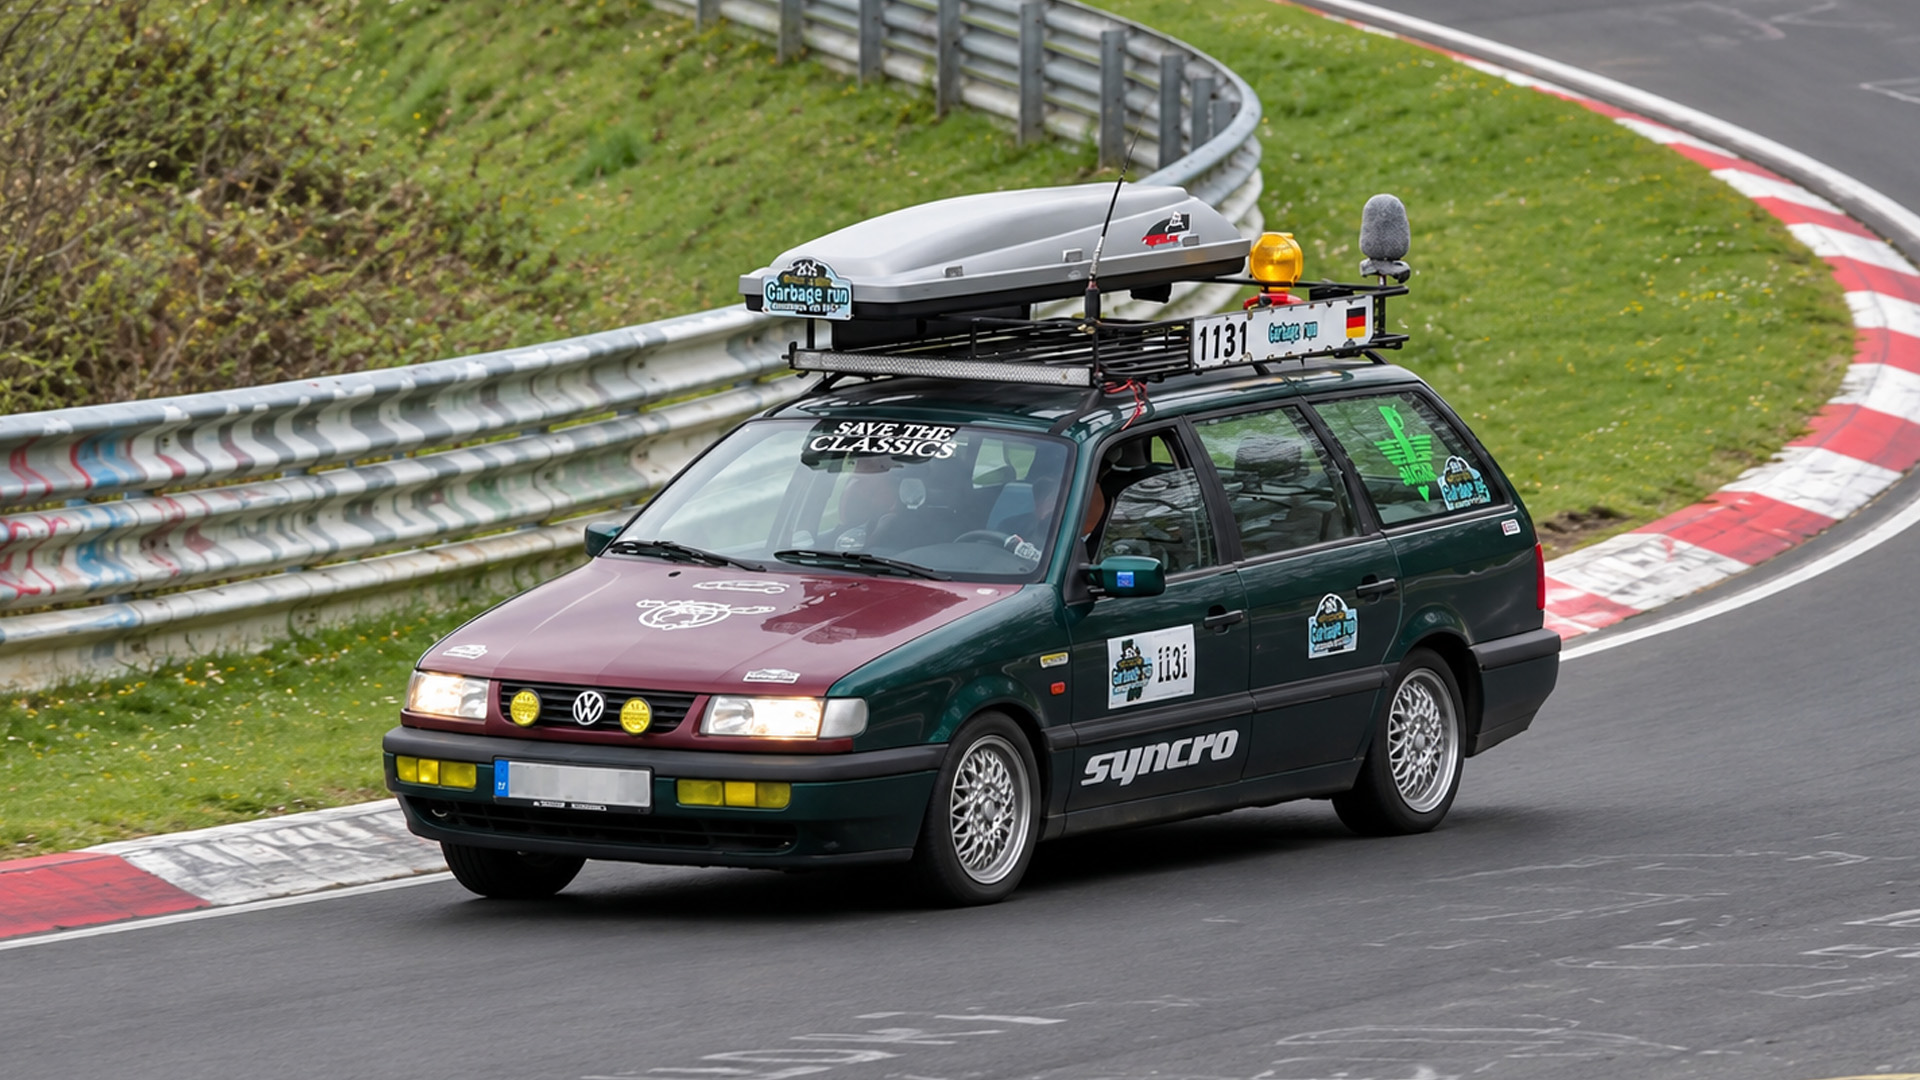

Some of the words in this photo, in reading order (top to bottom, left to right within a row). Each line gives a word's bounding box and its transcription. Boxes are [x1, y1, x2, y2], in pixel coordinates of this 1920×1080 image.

[766, 282, 823, 304] Garbage
[827, 287, 849, 303] run
[1199, 321, 1247, 361] 1131
[834, 421, 899, 437] SAVE
[901, 423, 956, 441] THE
[810, 434, 957, 460] CLASSICS
[1080, 729, 1239, 786] syncro
